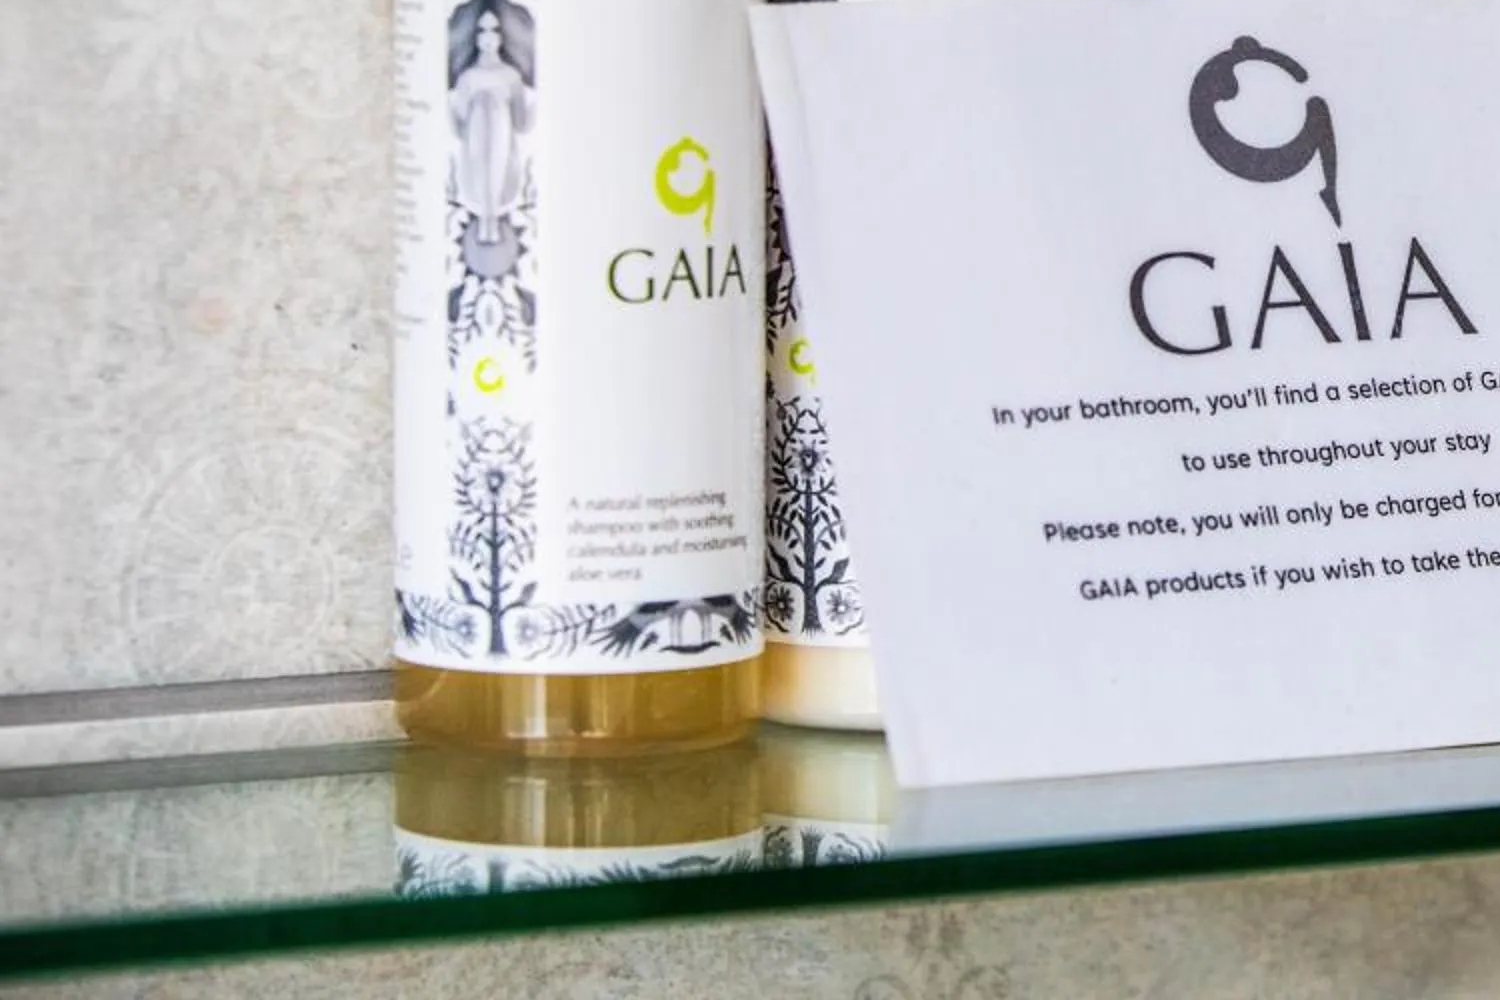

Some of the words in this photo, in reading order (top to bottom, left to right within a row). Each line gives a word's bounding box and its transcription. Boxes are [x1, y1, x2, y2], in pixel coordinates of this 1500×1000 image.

[607, 243, 747, 304] GAIA
[1128, 235, 1479, 356] GAIA
[991, 407, 1015, 425] In
[1020, 404, 1073, 429] your
[1078, 395, 1201, 420] bathroom,
[1205, 386, 1268, 417] you'll
[1273, 381, 1320, 406] find
[1324, 384, 1342, 402] a
[1346, 374, 1447, 401] selection
[1451, 370, 1474, 393] of
[1180, 453, 1207, 473] to
[1211, 452, 1252, 471] use
[1256, 438, 1386, 468] throughout
[1388, 436, 1438, 462] your
[1444, 432, 1492, 455] stay
[567, 519, 643, 536] shampoo
[647, 517, 679, 533] with
[685, 513, 734, 530] soothing
[585, 493, 642, 511] natural
[645, 490, 726, 514] replenishing
[1042, 521, 1121, 543] Please
[1126, 515, 1187, 537] note,
[1191, 513, 1234, 537] you
[1238, 504, 1281, 529] will
[1285, 500, 1333, 527] only
[1339, 498, 1370, 520] be
[1375, 488, 1467, 518] charged
[567, 541, 646, 558] calendula
[652, 539, 679, 556] and
[568, 565, 601, 582] aloe
[607, 567, 642, 581] vera
[1079, 576, 1140, 601] GAIA
[1144, 570, 1248, 600] products
[1250, 564, 1268, 587] if
[1273, 566, 1316, 591] you
[1320, 556, 1376, 582] wish
[1380, 556, 1406, 576] to
[1410, 550, 1462, 573] take
